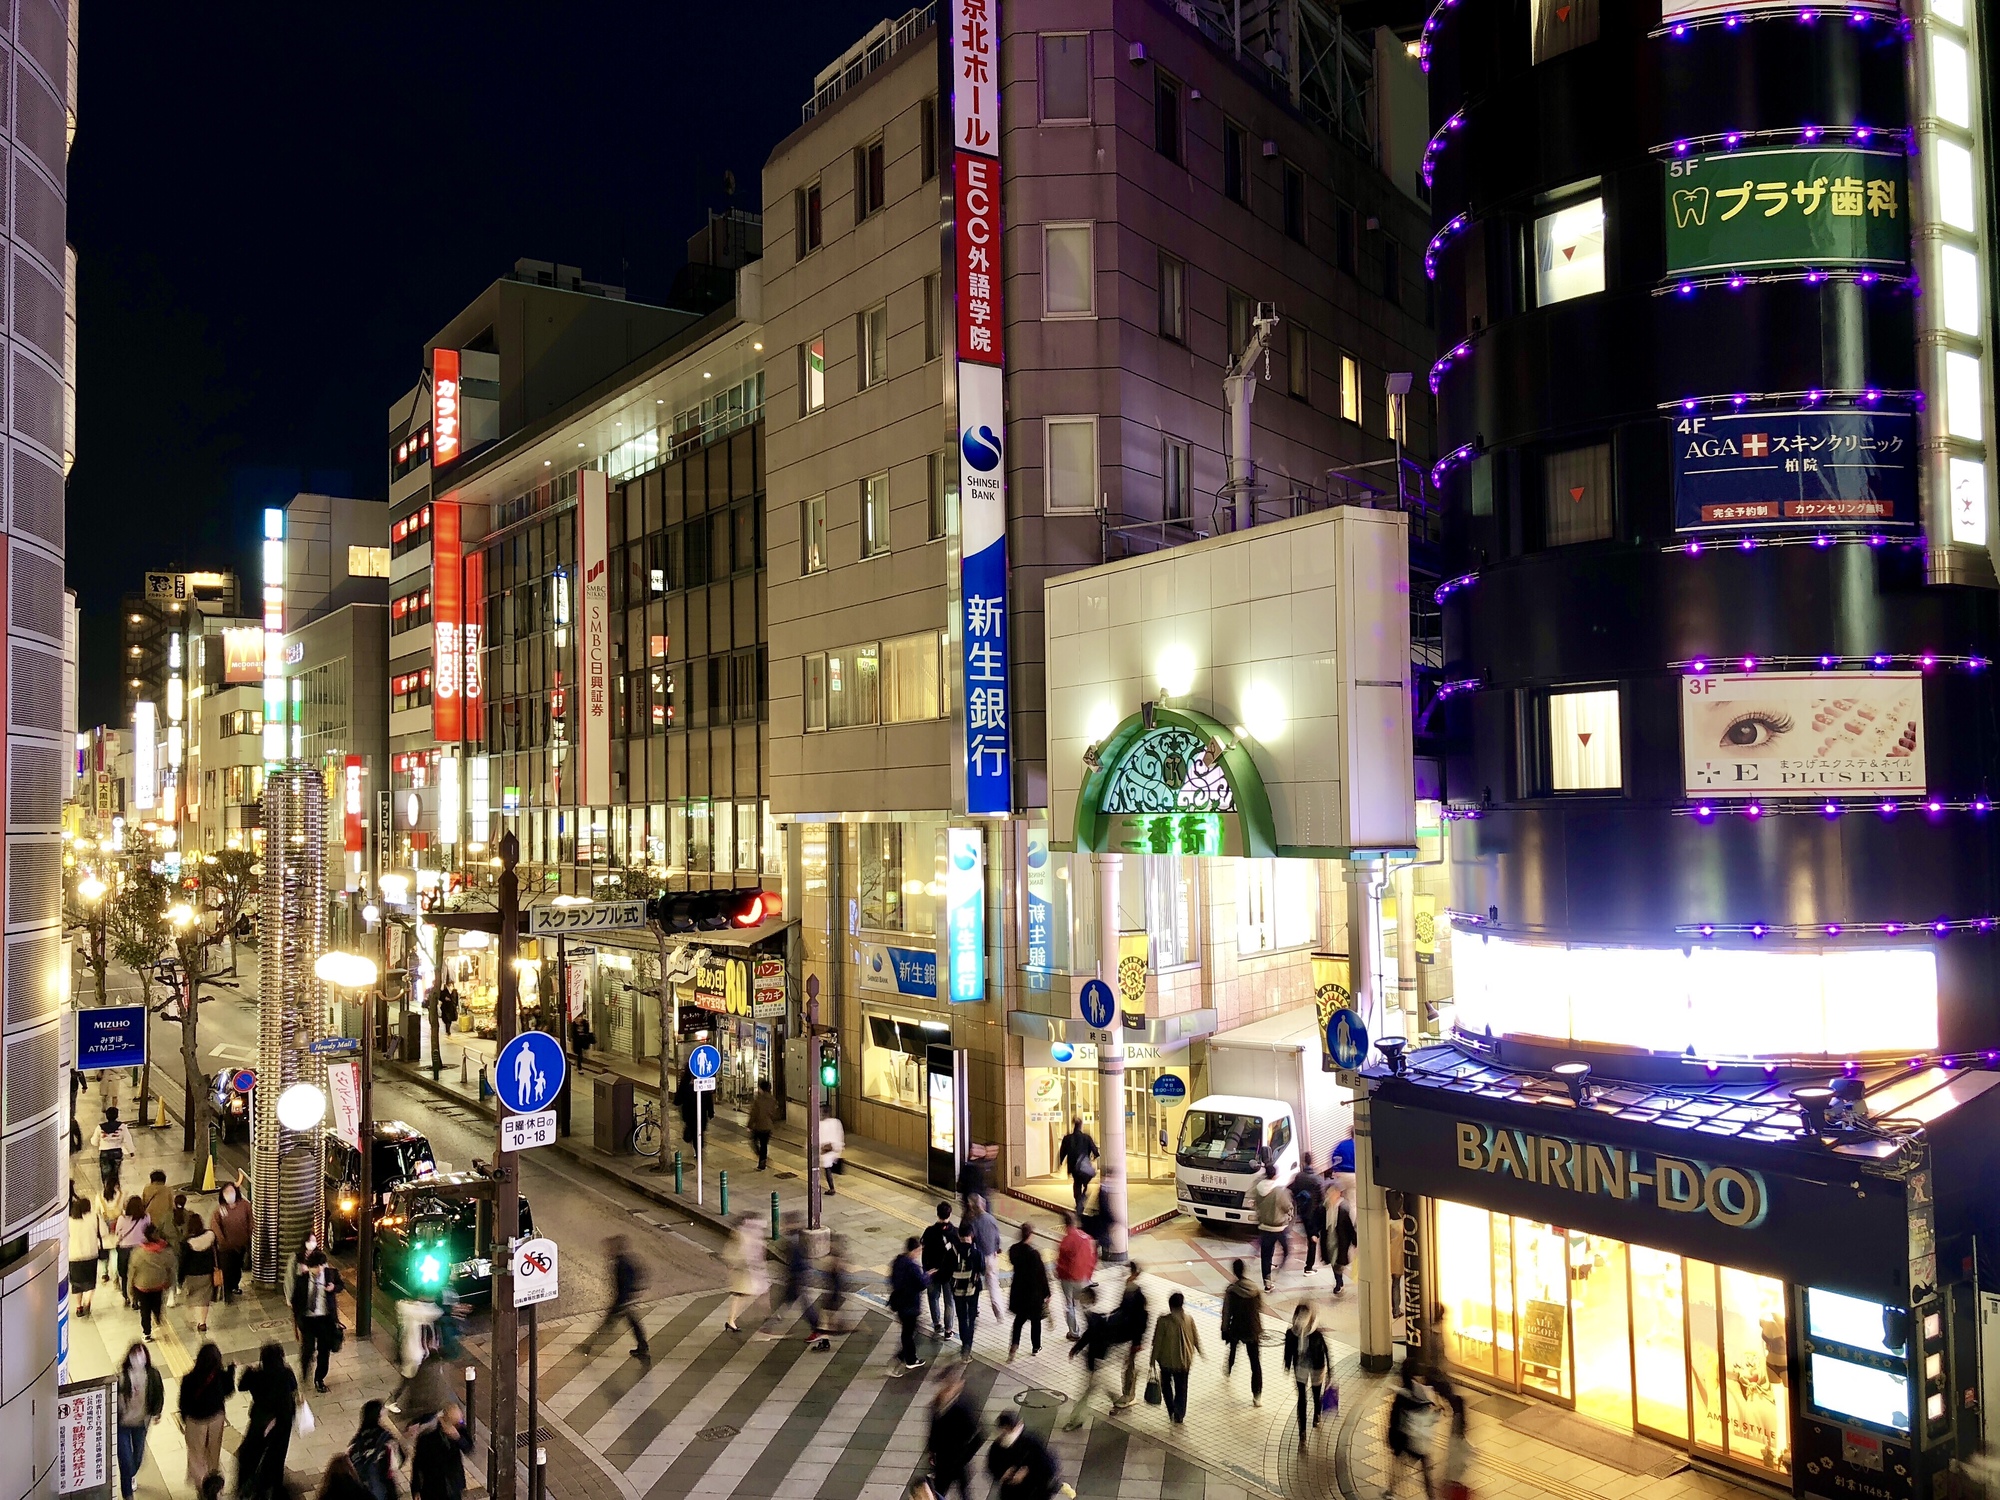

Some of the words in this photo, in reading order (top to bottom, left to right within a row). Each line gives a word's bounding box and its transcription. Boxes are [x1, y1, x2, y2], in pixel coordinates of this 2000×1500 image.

[1670, 159, 1699, 178] 5F
[1715, 176, 1898, 221] プラザ歯科
[966, 160, 991, 353] ECC外語学院
[436, 379, 457, 453] カラオケ
[1677, 418, 1706, 434] 4F
[1684, 439, 1739, 459] AGA
[1771, 434, 1904, 454] スキンクリニック
[1785, 458, 1818, 473] 柏院
[966, 475, 1000, 489] SHINSEI
[971, 488, 996, 501] BANK
[1713, 506, 1768, 518] 完全予約制
[1795, 504, 1884, 515] カウンセリング無料
[586, 584, 606, 592] SMBC
[436, 621, 454, 652] BIG
[590, 606, 604, 717] SMBC日興証券
[437, 653, 454, 698] ECHO
[967, 593, 1006, 777] 新生銀行
[1689, 678, 1717, 695] 3F
[1780, 758, 1912, 769] まつげエクステ&ネイル
[1732, 763, 1759, 782] E
[1780, 771, 1852, 783] PLUS
[1860, 771, 1912, 783] EYE
[381, 800, 389, 848] サンマルク
[1120, 816, 1207, 855] 二番街
[538, 905, 639, 928] スクランブル式
[956, 906, 976, 996] 新生銀行
[756, 964, 782, 975] ハンコ
[899, 960, 936, 985] 新生銀
[697, 967, 725, 991] 認め印
[725, 958, 747, 1017] 80
[757, 991, 781, 1002] 合カギ
[94, 1020, 130, 1029] MIZUHO
[100, 1035, 123, 1044] みずほ
[1090, 1031, 1107, 1042] 終日
[88, 1043, 136, 1053] ATMコーナー
[314, 1042, 336, 1051] Howdy
[337, 1040, 353, 1048] Mall
[1128, 1046, 1161, 1059] BANK
[1341, 1073, 1361, 1087] 終日
[1456, 1122, 1754, 1227] BAIRIN-DO
[1403, 1213, 1422, 1347] BAIRIN-DO
[1535, 1317, 1553, 1329] ALL
[1742, 1422, 1776, 1438] STYLE
[1834, 1475, 1893, 1500] 創業1948年
